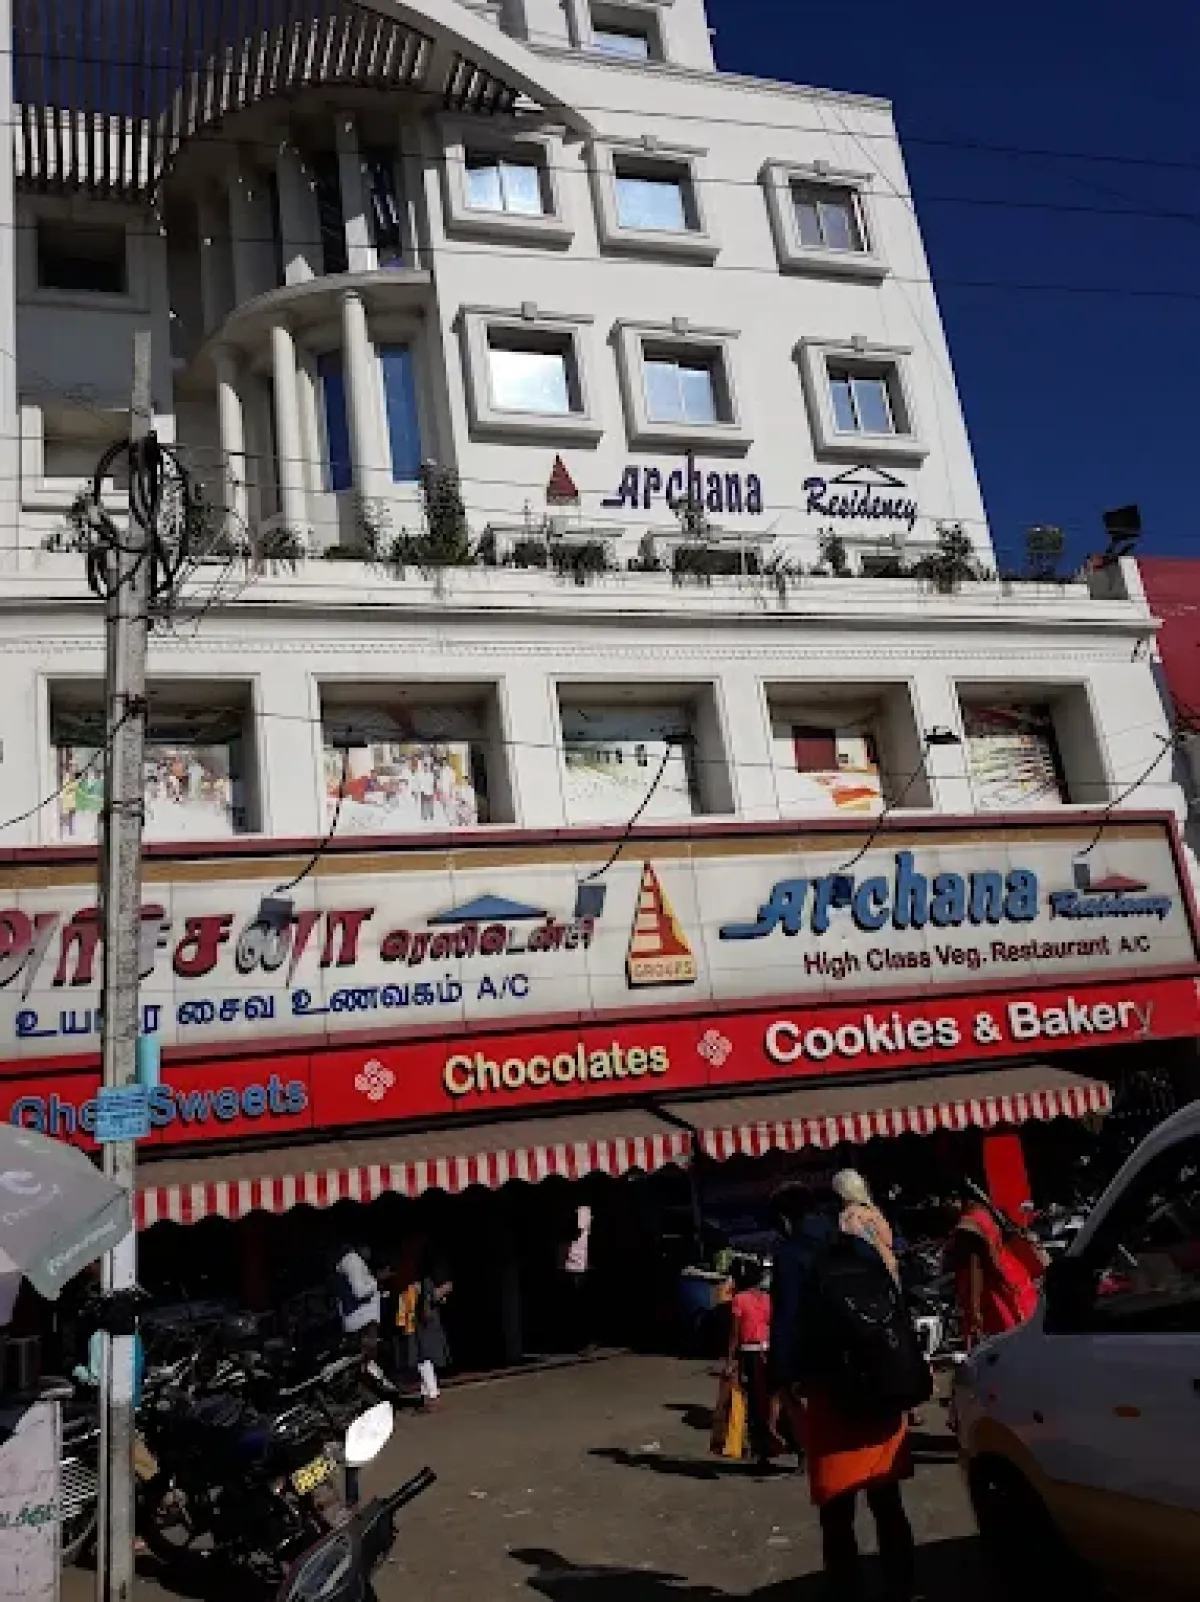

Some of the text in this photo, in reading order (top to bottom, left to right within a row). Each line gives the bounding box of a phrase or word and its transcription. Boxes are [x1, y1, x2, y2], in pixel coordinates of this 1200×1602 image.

[801, 476, 917, 531] Residency
[719, 851, 1039, 939] Archana
[804, 951, 860, 980] High
[866, 948, 933, 971] Class
[935, 944, 988, 970] Veg.
[991, 935, 1110, 963] Restaurant
[477, 973, 530, 1000] A/C
[765, 996, 1152, 1063] Cookies & Bakery
[443, 1041, 670, 1094] Chocolates
[149, 1073, 309, 1128] Sweets
